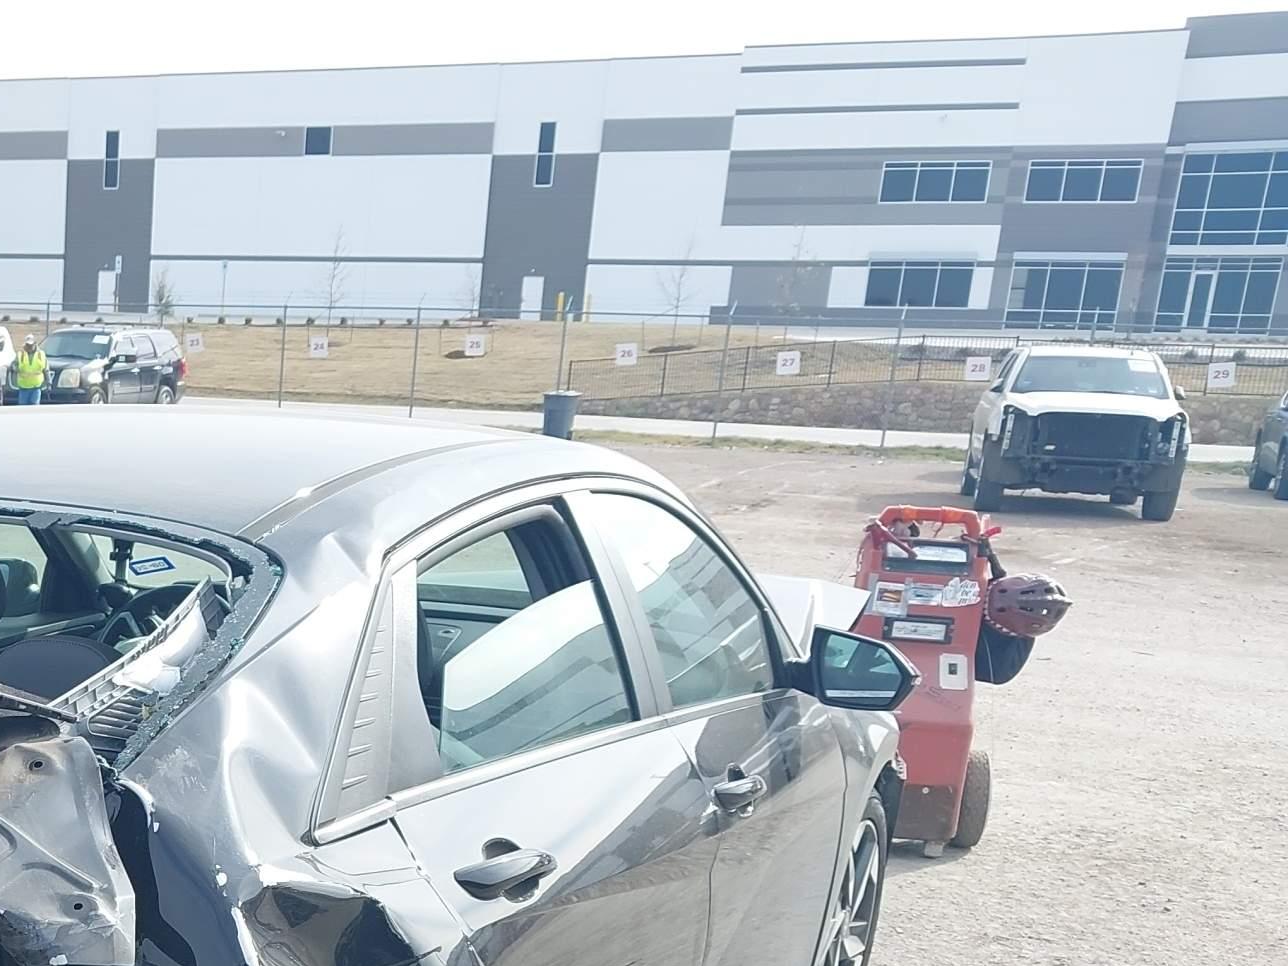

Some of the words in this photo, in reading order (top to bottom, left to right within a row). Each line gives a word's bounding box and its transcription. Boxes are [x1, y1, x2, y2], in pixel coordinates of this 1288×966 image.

[781, 358, 796, 367] 27
[971, 363, 986, 373] 28
[1212, 369, 1230, 379] 29
